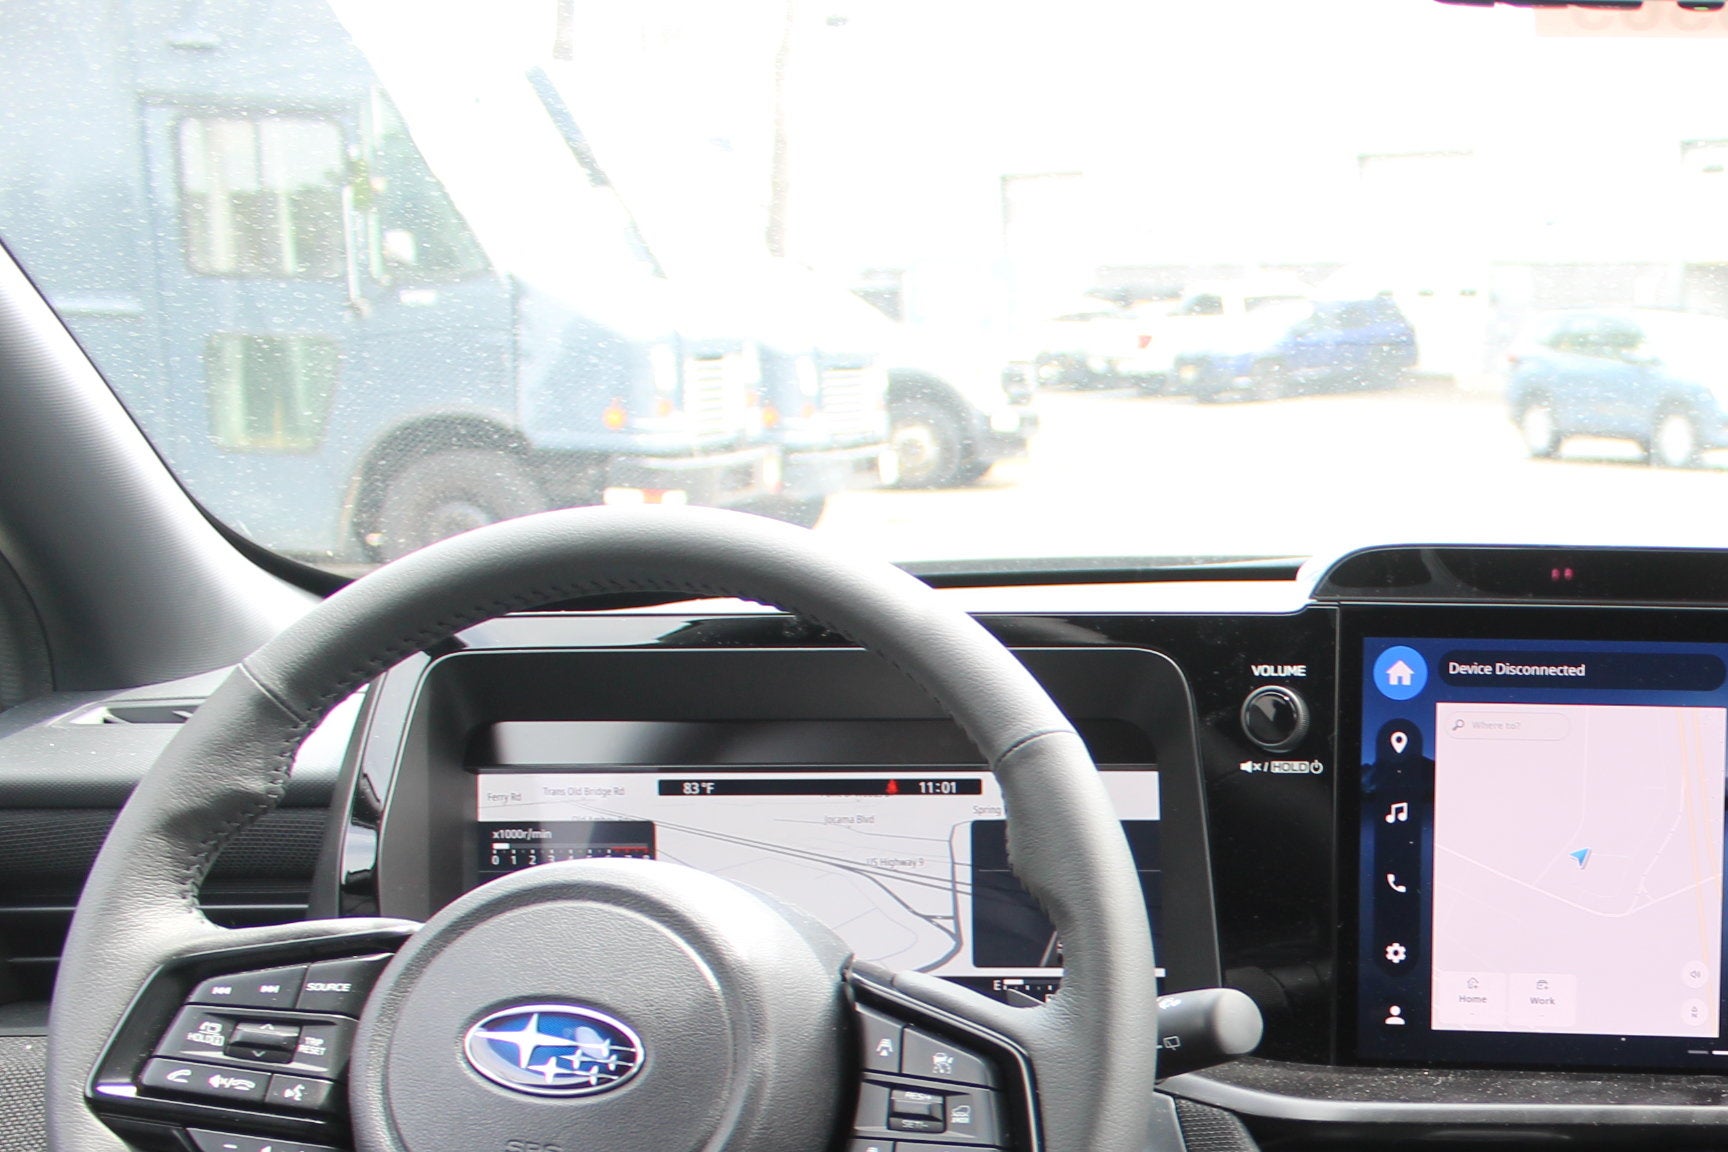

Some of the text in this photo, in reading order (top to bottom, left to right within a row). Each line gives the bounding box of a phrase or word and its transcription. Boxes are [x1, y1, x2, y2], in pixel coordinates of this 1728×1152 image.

[1251, 665, 1307, 676] VOLUME
[1449, 662, 1585, 677] Device Disconnected
[585, 787, 612, 798] Bridge
[613, 786, 625, 796] Rd
[918, 782, 957, 794] 11:01
[972, 805, 1002, 817] Spring
[492, 828, 552, 840] x1000r/min
[492, 856, 499, 865] 0
[511, 856, 517, 865] 1
[529, 856, 536, 865] 2
[882, 858, 916, 869] Highway
[305, 982, 352, 992] SOURCE
[1459, 995, 1487, 1003] Home
[1530, 997, 1555, 1005] Work
